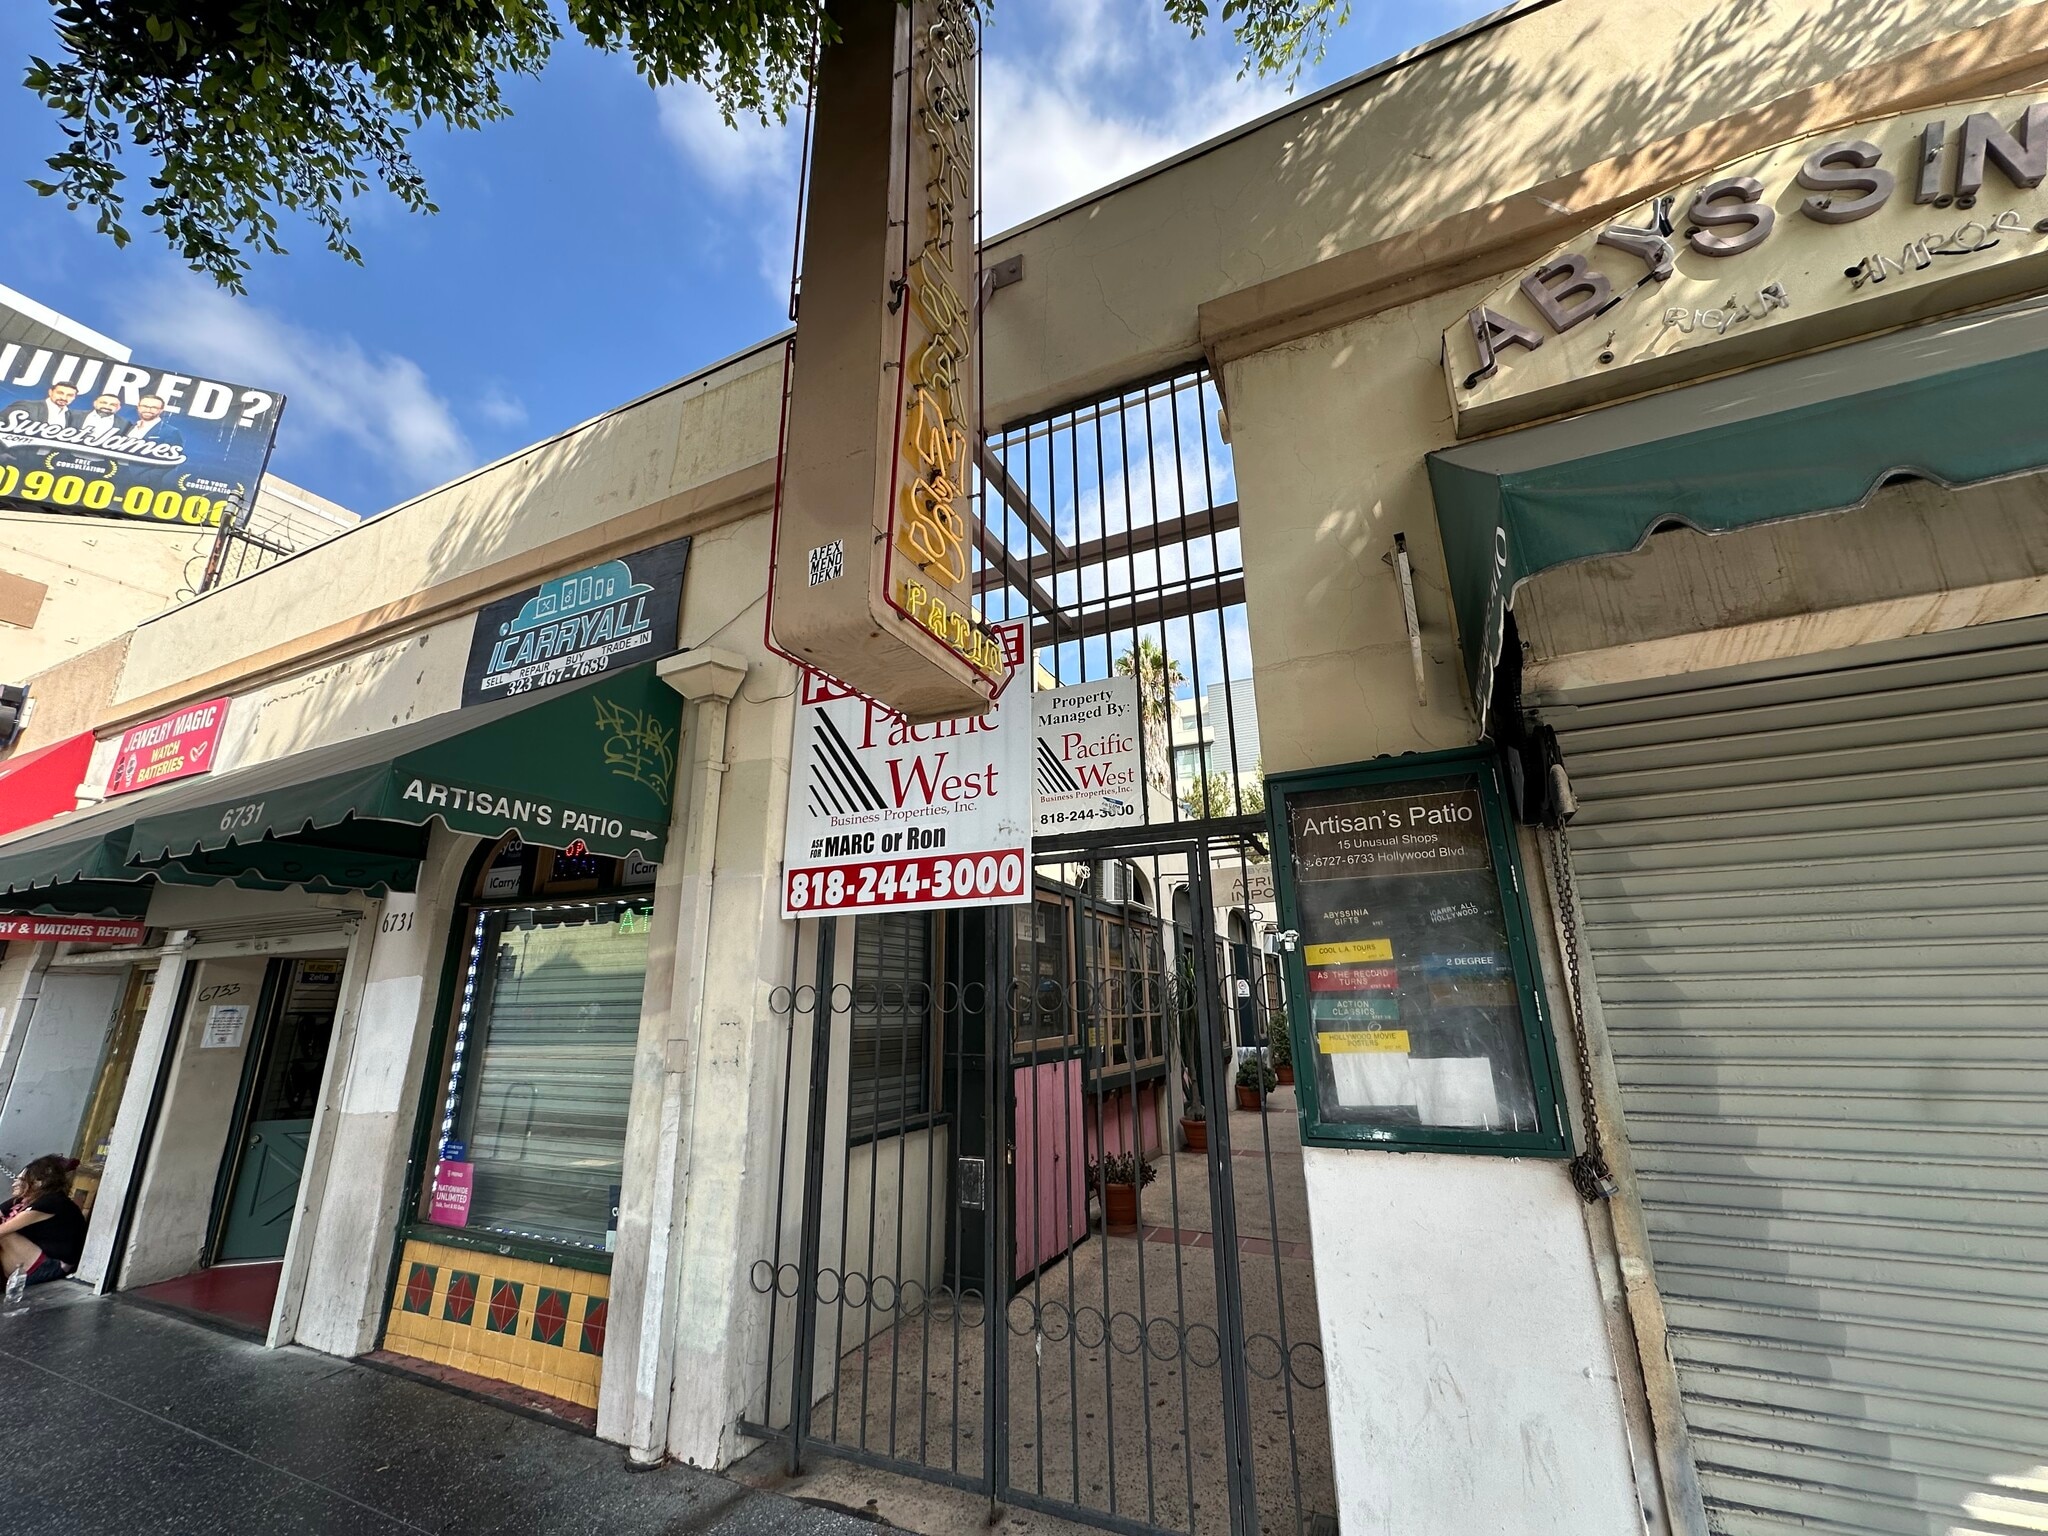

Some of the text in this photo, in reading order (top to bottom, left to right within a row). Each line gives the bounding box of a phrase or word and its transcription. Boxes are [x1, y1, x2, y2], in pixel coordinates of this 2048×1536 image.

[186, 481, 233, 495] CONSIDERATIO
[519, 661, 550, 678] REPAIR
[565, 652, 585, 667] BUY
[601, 638, 633, 656] TRADE
[506, 655, 609, 697] 323 467-7689
[1052, 689, 1114, 710] Property
[1038, 702, 1130, 728] Managed By:
[124, 705, 218, 754] JEWELRY MAGIC
[150, 739, 181, 763] WATCH
[1061, 733, 1133, 762] Pacific
[136, 755, 185, 783] BATTERIES
[1075, 761, 1135, 790] West
[885, 751, 999, 809] West
[1040, 792, 1073, 804] Business
[219, 801, 266, 831] 6731
[402, 778, 624, 839] ARTISAN'S PATIO
[830, 800, 977, 828] Business Properties, Inc.
[1303, 802, 1473, 838] Artisan's Patio
[811, 838, 824, 849] ASK
[824, 825, 946, 858] MARC or Ron
[1337, 832, 1439, 851] 15 Unusual Shops
[810, 848, 822, 859] FOR
[1315, 852, 1375, 868] 6727-6733
[1377, 848, 1436, 864] Hollywood
[790, 853, 1022, 909] 818-244-3000
[1323, 908, 1369, 920] ABYSSINIA
[1431, 907, 1479, 924] HOLLYWOOD
[1460, 902, 1476, 910] ALL
[18, 922, 30, 935] &
[34, 922, 95, 937] WATCHES
[96, 925, 140, 938] REPAIR
[382, 911, 415, 933] 6731
[1334, 916, 1360, 926] GIFTS
[1353, 943, 1377, 952] TOURS
[1446, 956, 1494, 966] 2 DEGREE
[1317, 968, 1389, 980] AS THE RECORD
[1340, 977, 1368, 987] TURNS
[199, 982, 241, 1002] 6733
[1332, 1007, 1376, 1016] CLASSICS
[1336, 1000, 1370, 1009] ACTION
[1329, 1031, 1396, 1041] HOLLYWOOD MOVIE
[436, 1192, 468, 1204] UNLIMITED
[438, 1184, 469, 1195] NATIONWIDE
